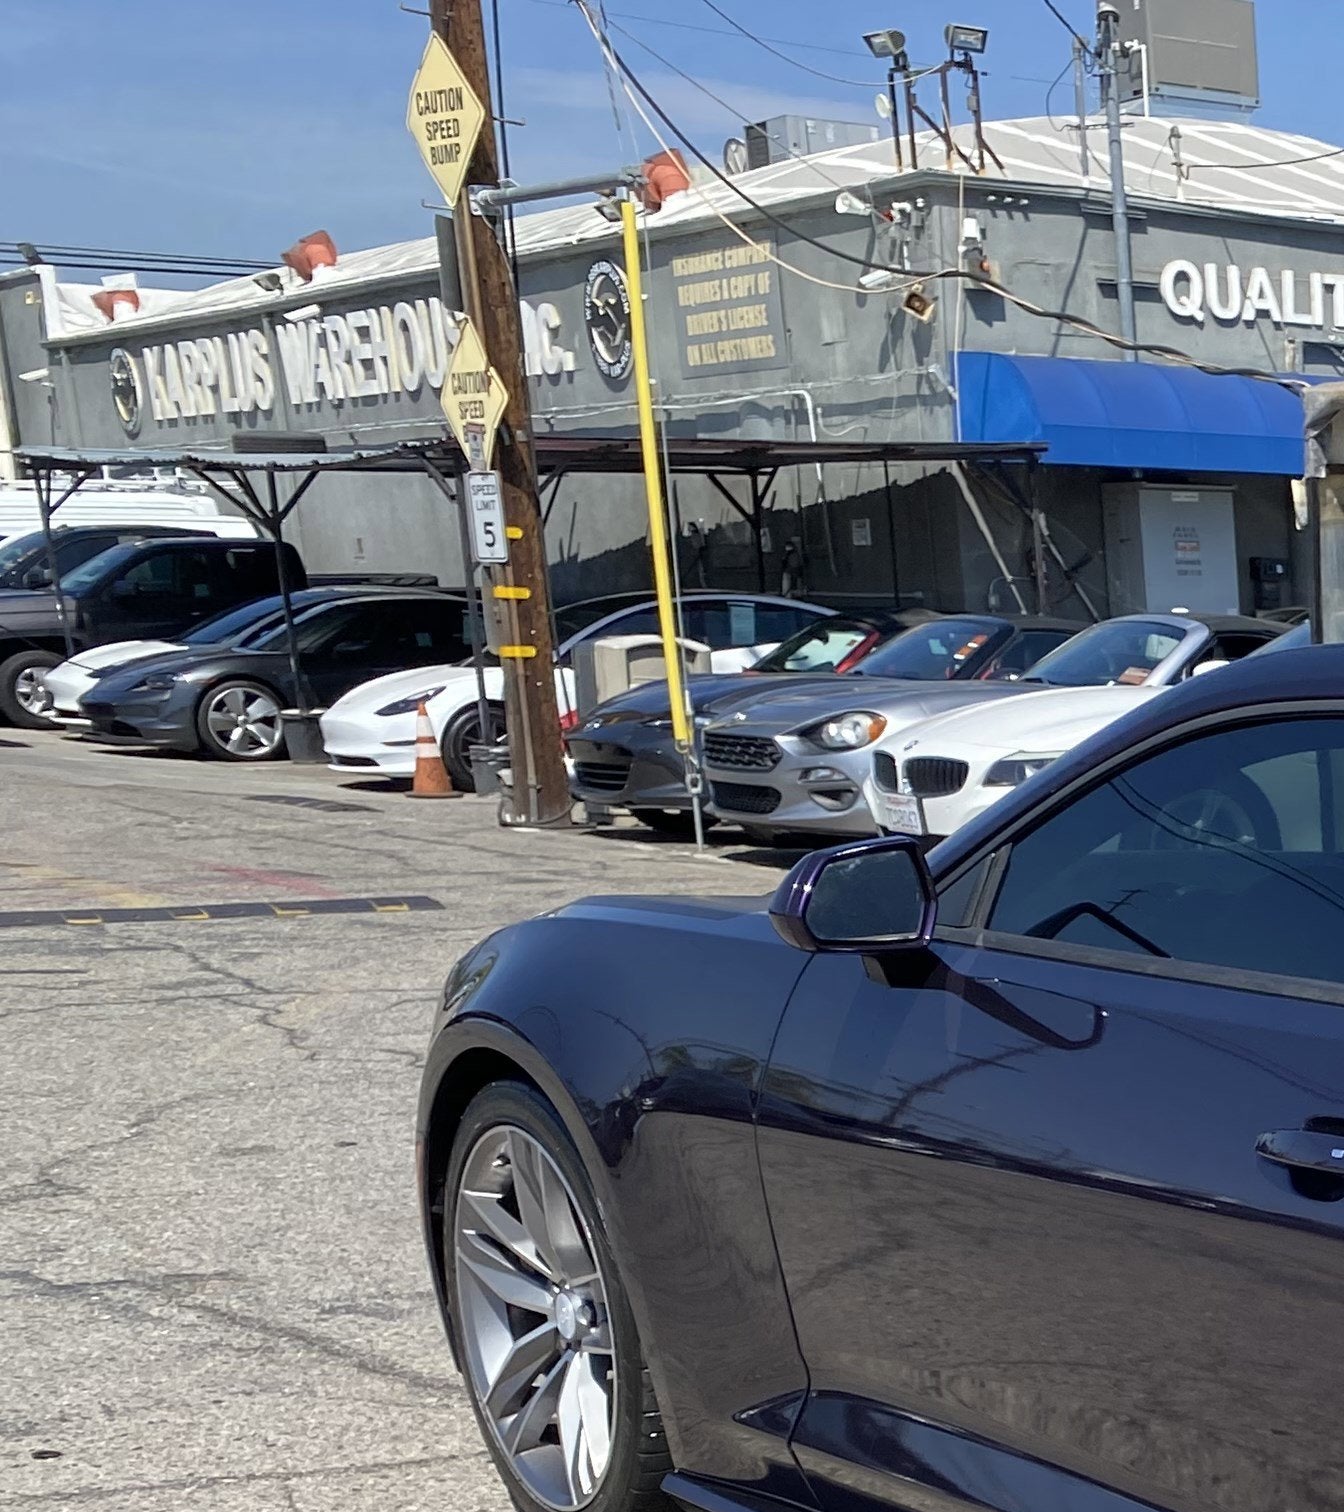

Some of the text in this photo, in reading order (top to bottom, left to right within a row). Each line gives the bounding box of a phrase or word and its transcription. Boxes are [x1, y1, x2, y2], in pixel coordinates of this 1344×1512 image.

[416, 86, 464, 116] CAUTION
[425, 118, 460, 141] SPEED
[430, 143, 461, 165] BUMP
[142, 329, 274, 421] KARPLUS
[519, 299, 575, 376] NC.
[452, 370, 489, 396] CAUTION
[459, 401, 484, 420] SPEED
[471, 484, 497, 495] SPEED
[476, 500, 496, 511] LIMIT
[483, 521, 496, 548] 5
